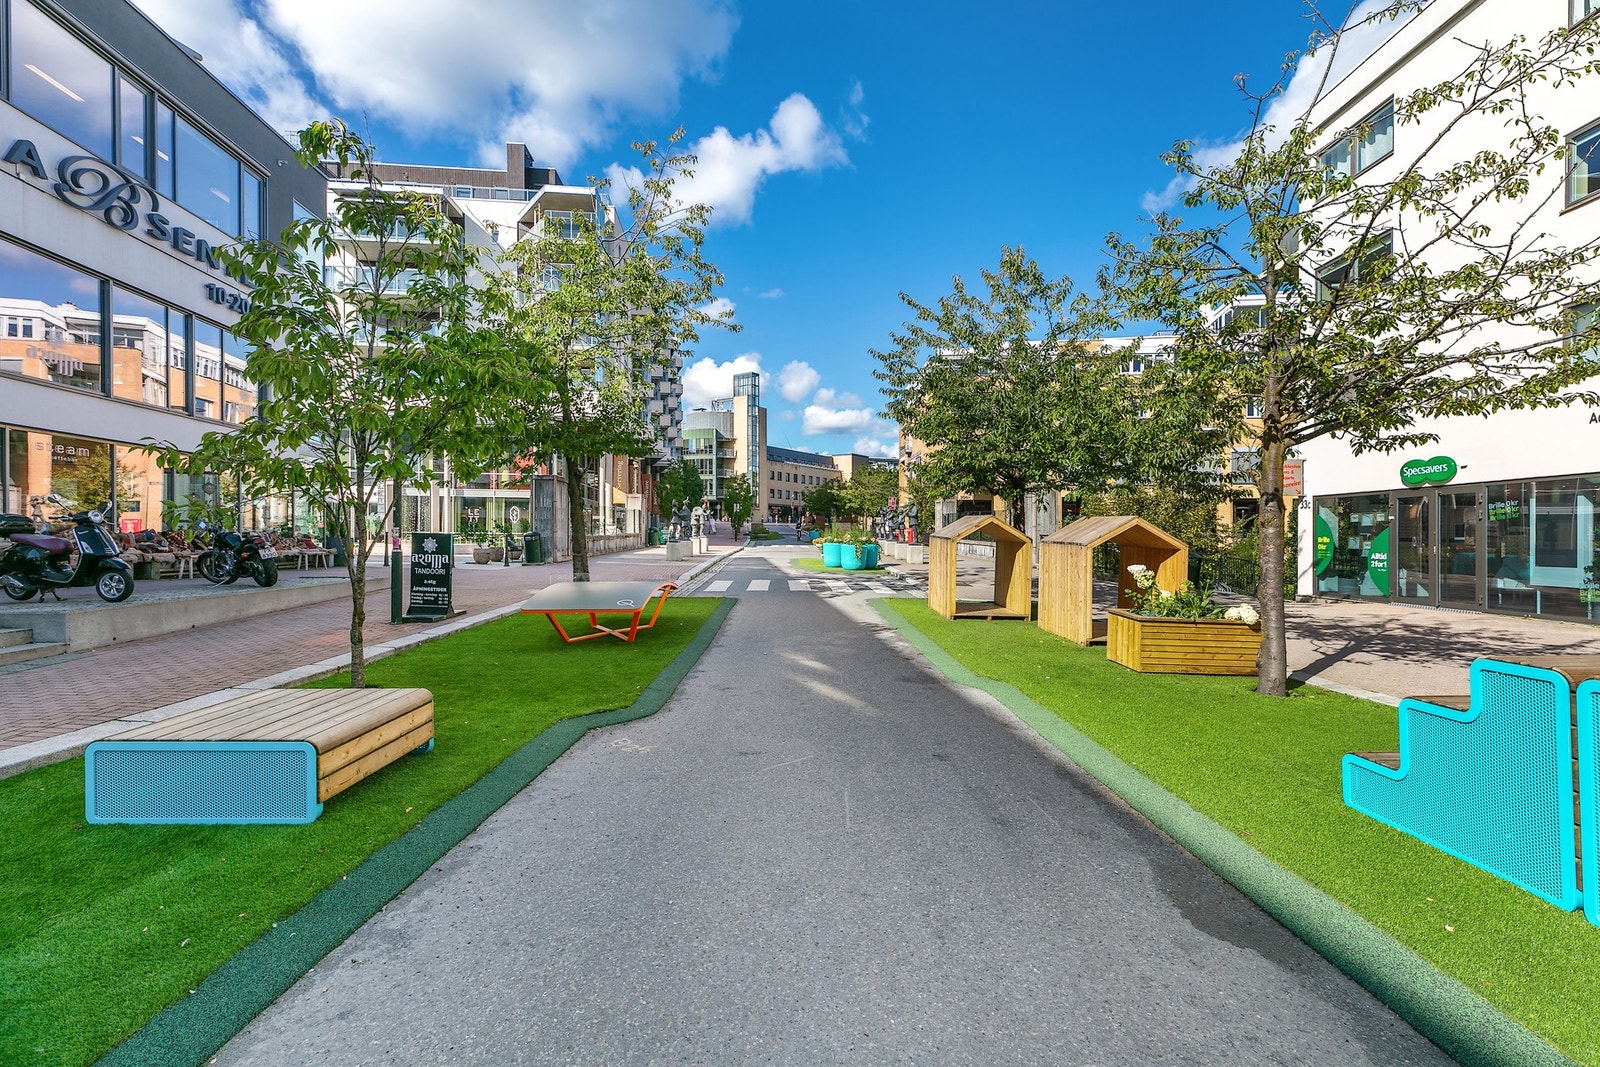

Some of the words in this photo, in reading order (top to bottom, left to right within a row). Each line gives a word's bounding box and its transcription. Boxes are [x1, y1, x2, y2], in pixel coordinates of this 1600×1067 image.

[35, 442, 90, 457] steam
[1403, 463, 1448, 478] Specsavers
[411, 553, 449, 568] aroma
[1370, 552, 1387, 560] Alltid
